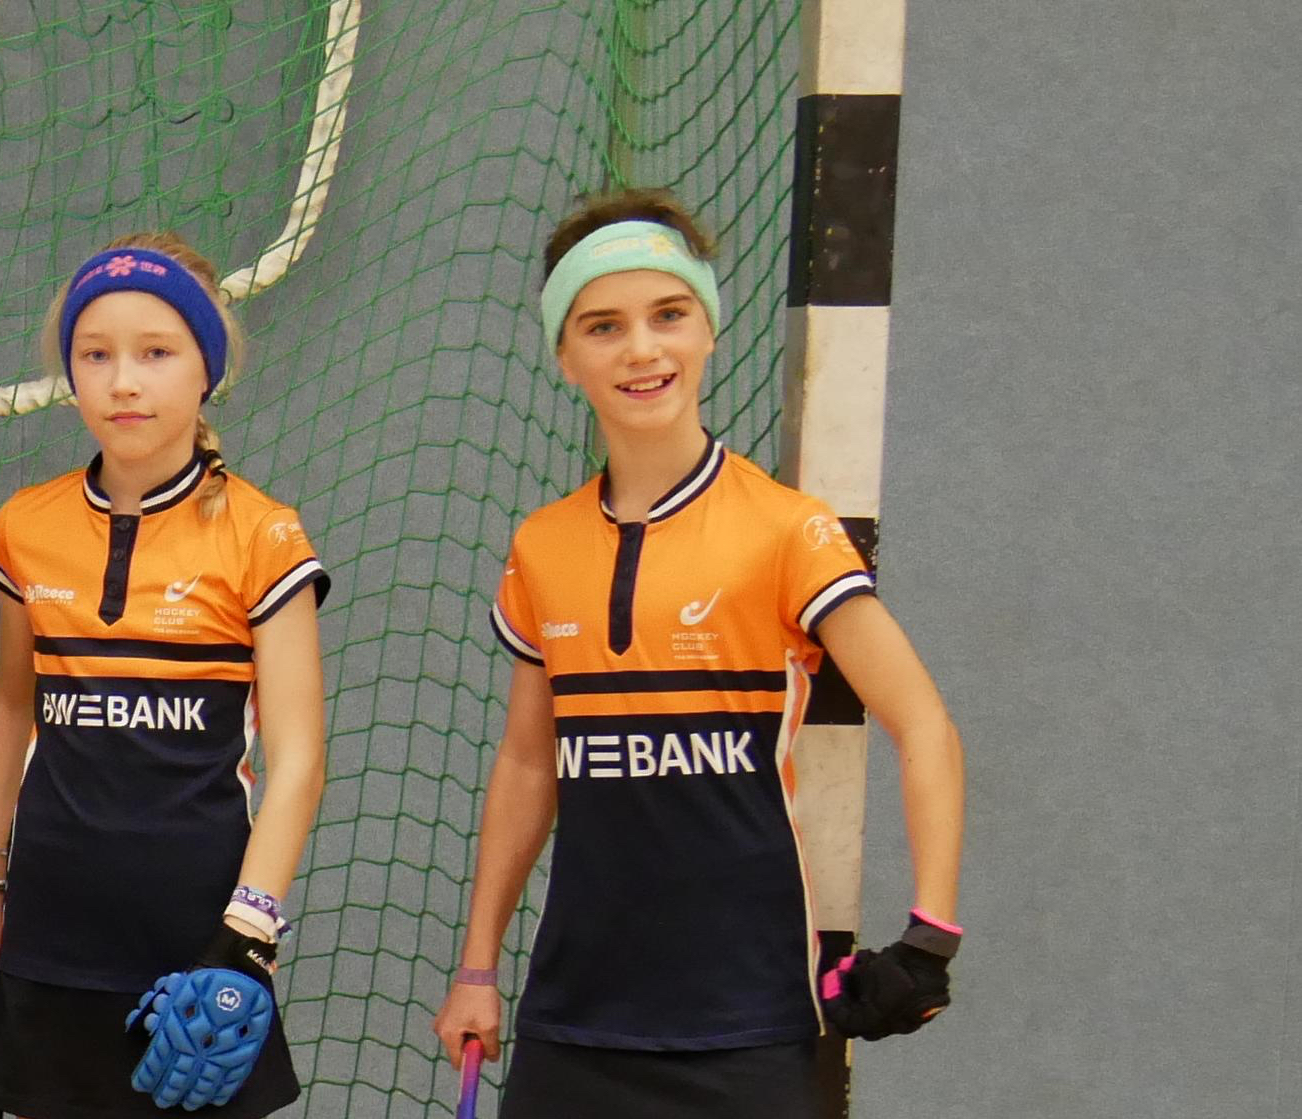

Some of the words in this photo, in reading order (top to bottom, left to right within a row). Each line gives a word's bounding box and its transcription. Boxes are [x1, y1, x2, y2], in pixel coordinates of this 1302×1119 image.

[154, 608, 201, 617] HOCKEY
[154, 617, 185, 625] CLUB
[672, 632, 720, 641] HOCKEY
[672, 642, 705, 651] CLUB
[108, 694, 207, 730] BANK
[629, 730, 755, 777] BANK
